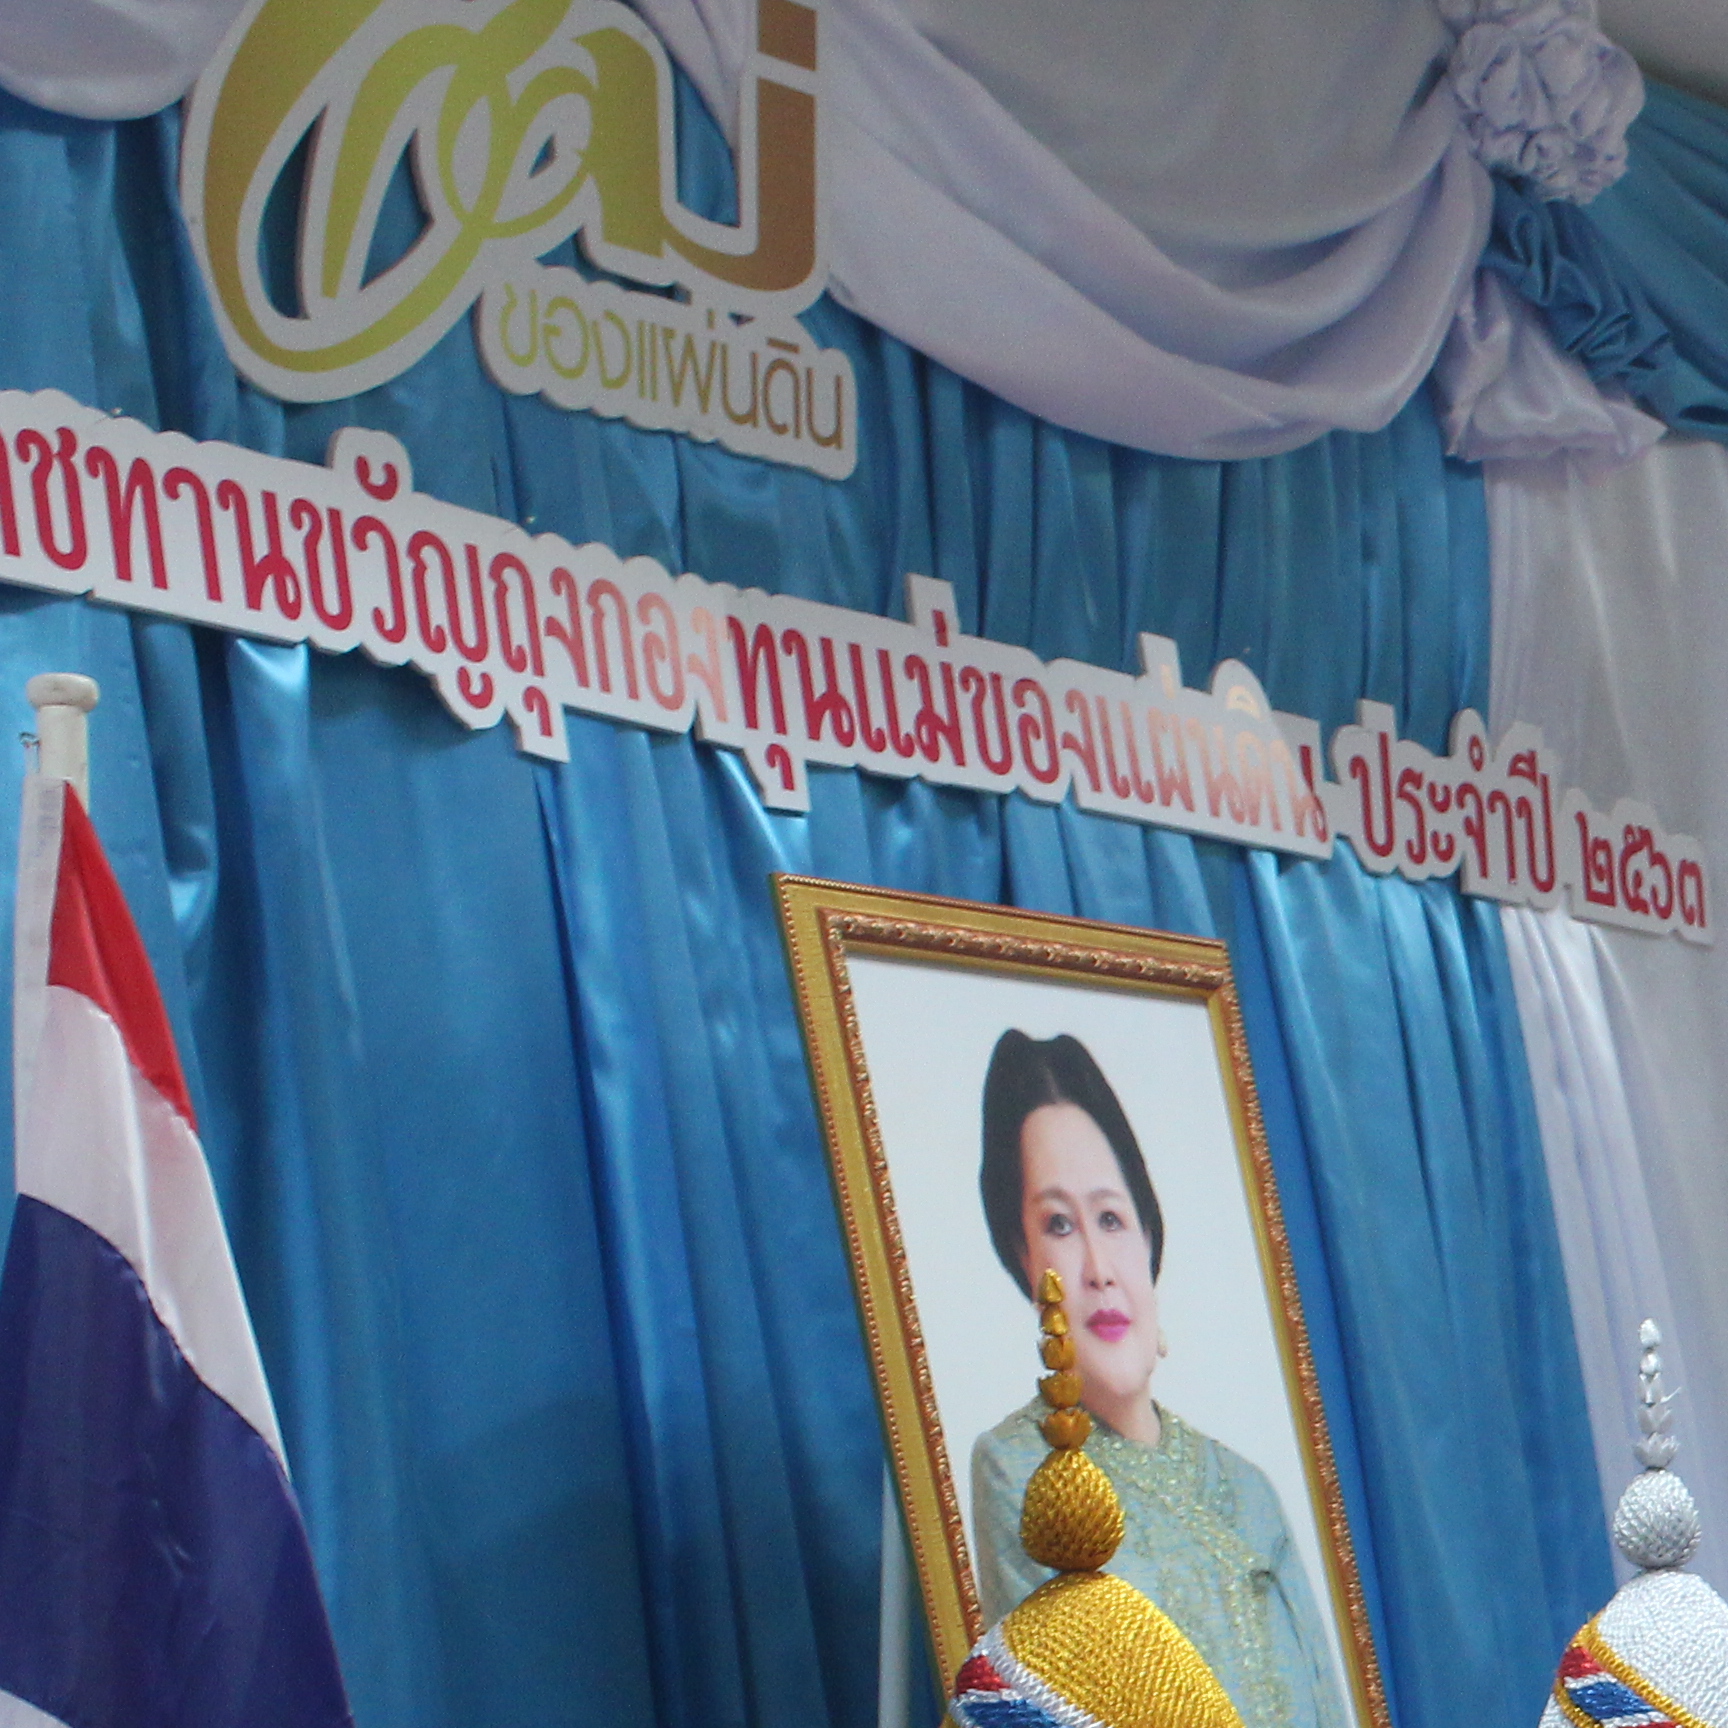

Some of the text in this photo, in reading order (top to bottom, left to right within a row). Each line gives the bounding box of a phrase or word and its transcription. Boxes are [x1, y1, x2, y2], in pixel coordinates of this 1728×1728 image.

[502, 282, 843, 450] ของแผ่นดิน
[1349, 731, 1557, 894] ประจำปี
[1575, 810, 1707, 928] ๒๕๖๓
